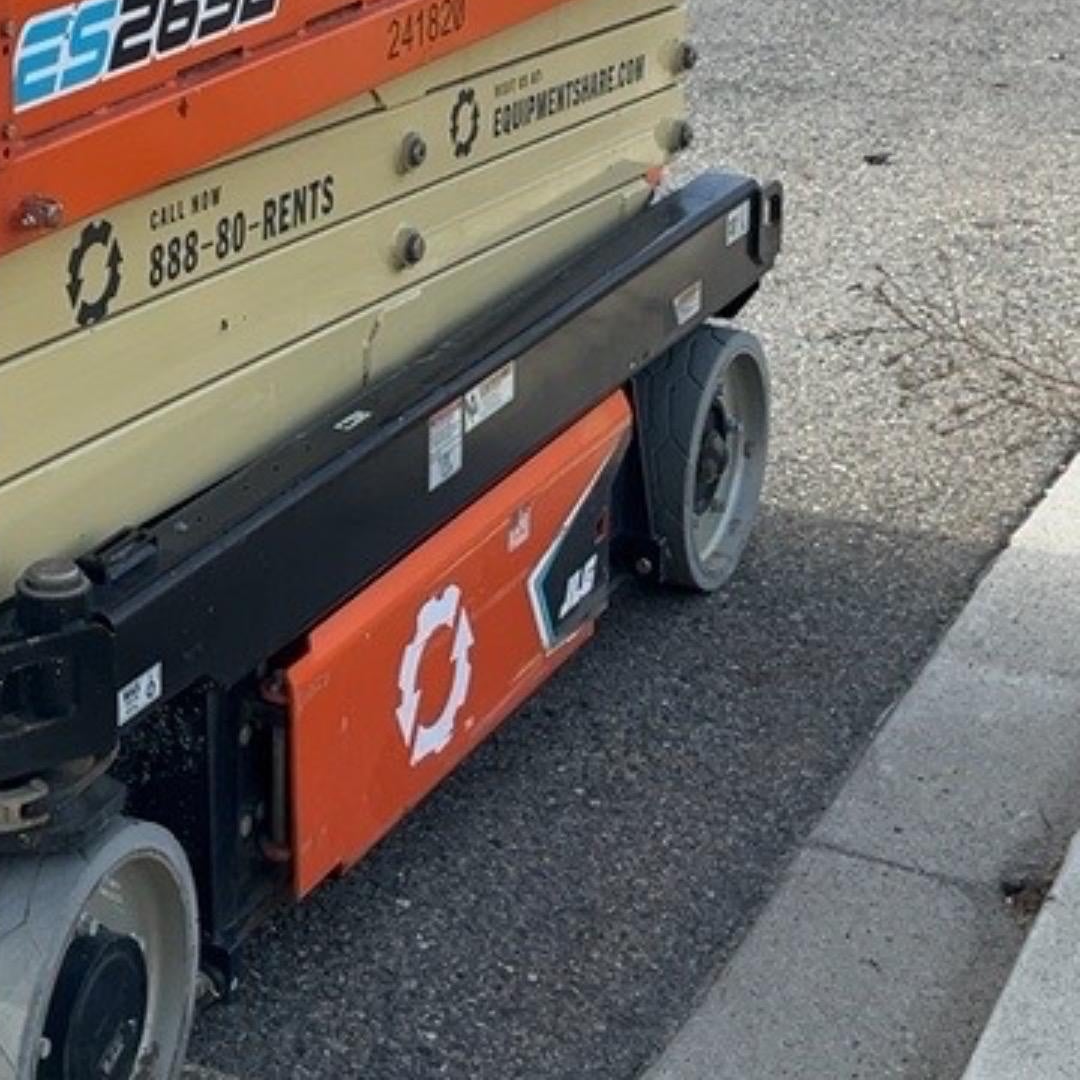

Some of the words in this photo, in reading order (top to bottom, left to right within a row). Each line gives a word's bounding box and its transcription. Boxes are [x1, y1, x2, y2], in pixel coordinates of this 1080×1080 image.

[149, 199, 185, 231] CALL
[191, 185, 223, 214] NOW
[149, 174, 335, 289] 888-80-RENTS
